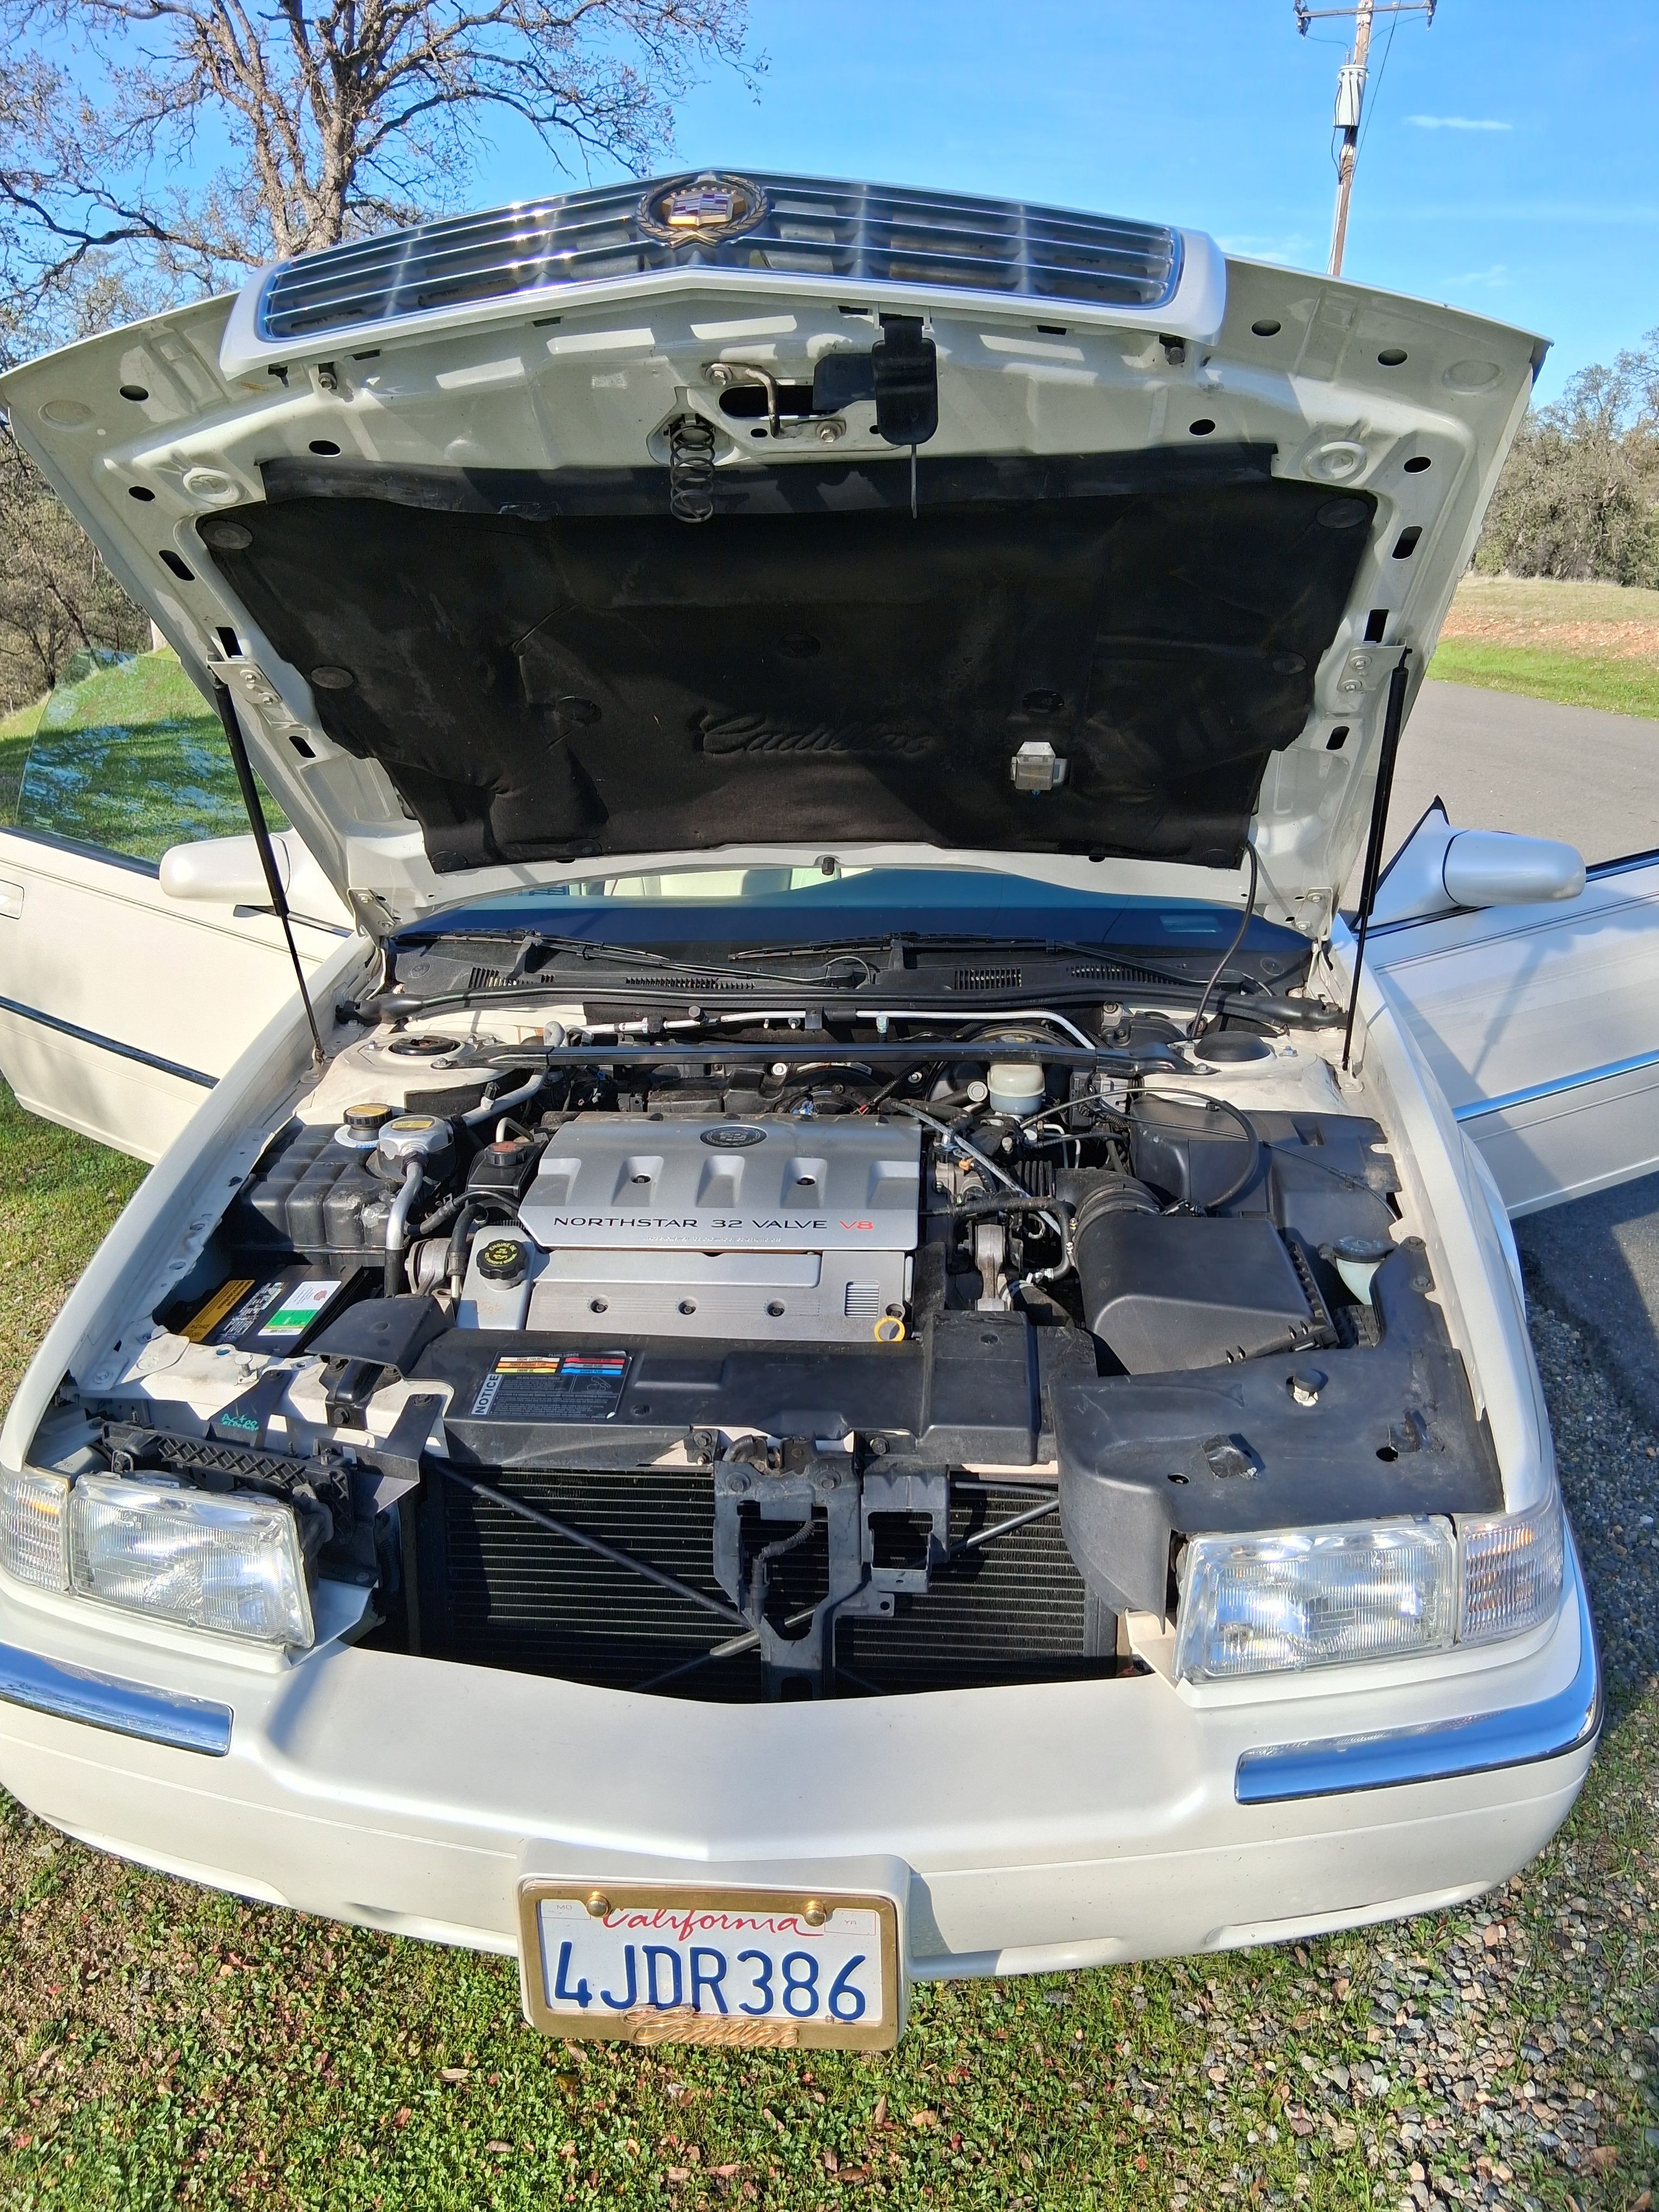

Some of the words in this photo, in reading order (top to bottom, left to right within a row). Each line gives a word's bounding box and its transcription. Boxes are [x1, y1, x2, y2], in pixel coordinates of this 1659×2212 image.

[553, 1217, 698, 1227] NORTHSTAR
[711, 1219, 743, 1229] 32
[751, 1219, 827, 1229] VALVE
[839, 1220, 873, 1230] V8
[474, 1374, 500, 1414] NOTICE
[602, 1908, 825, 1941] California
[554, 1941, 866, 2021] 4JDR386
